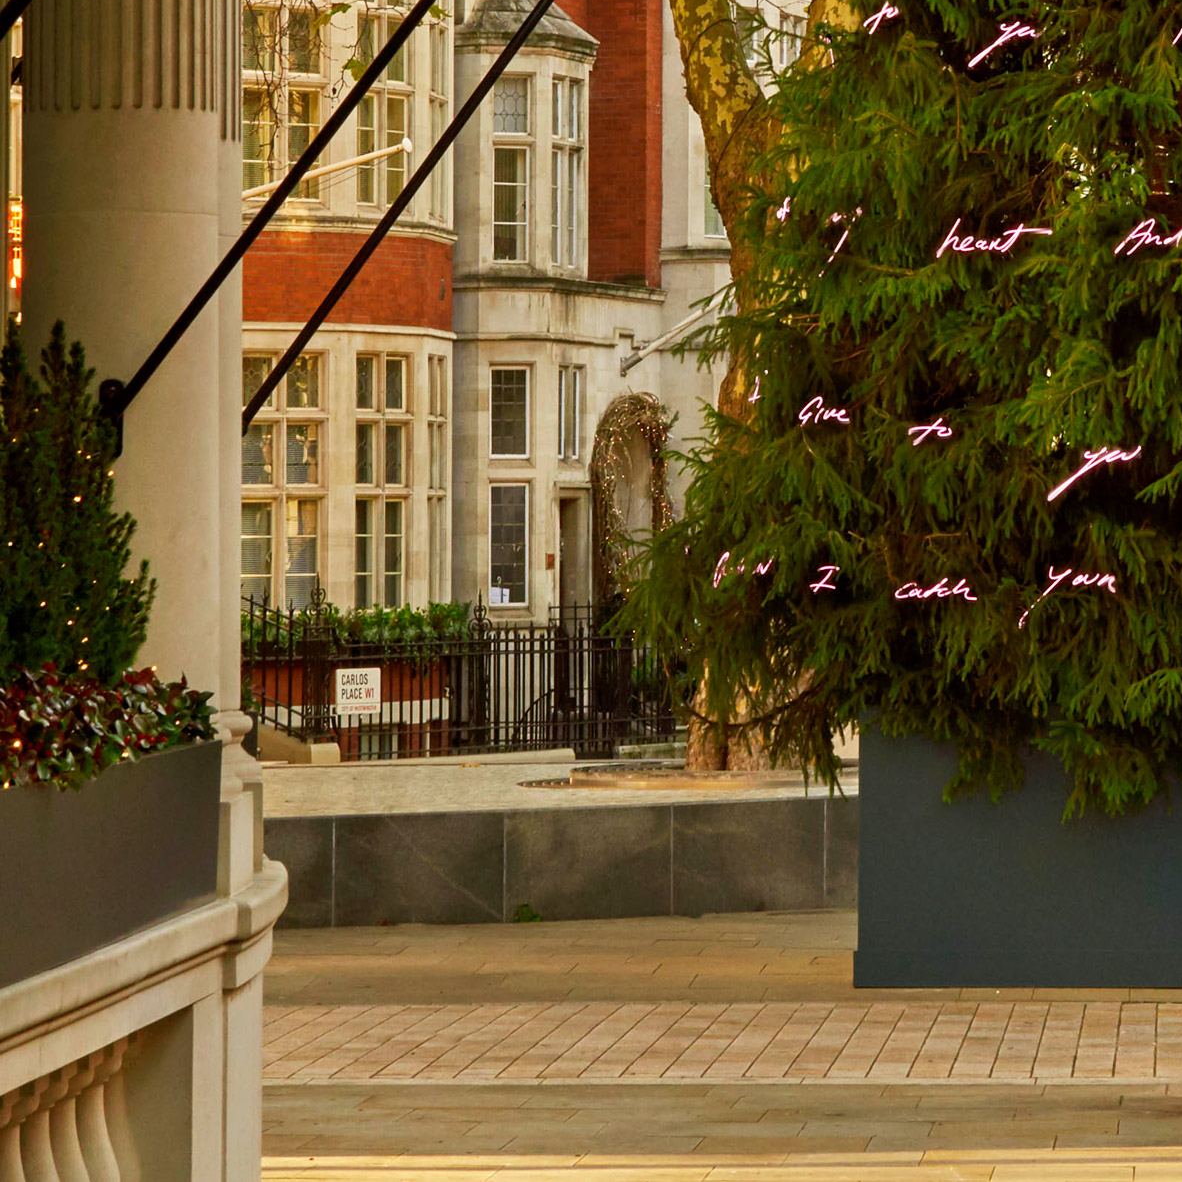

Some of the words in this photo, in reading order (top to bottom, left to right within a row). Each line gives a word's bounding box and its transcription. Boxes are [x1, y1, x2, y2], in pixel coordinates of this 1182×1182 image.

[936, 217, 1053, 258] heart
[798, 395, 850, 427] Give
[908, 417, 953, 446] to
[809, 565, 840, 593] I
[894, 576, 978, 602] catch
[341, 673, 368, 685] CARLOS
[341, 688, 362, 699] PLACE
[364, 688, 374, 698] W1
